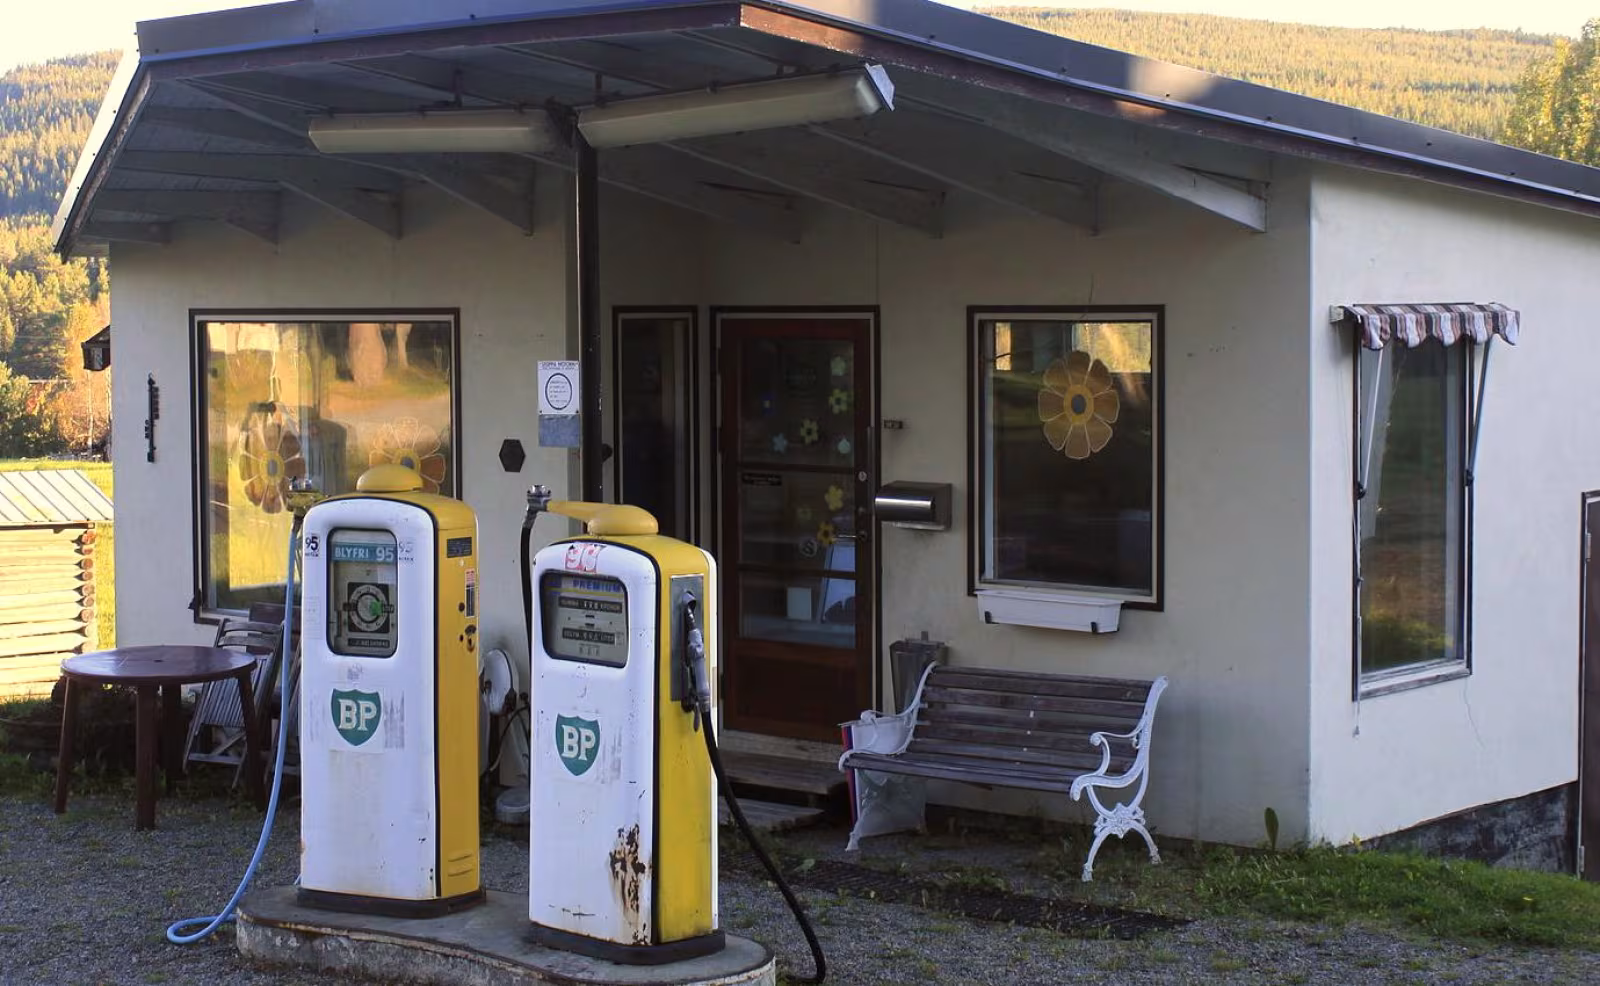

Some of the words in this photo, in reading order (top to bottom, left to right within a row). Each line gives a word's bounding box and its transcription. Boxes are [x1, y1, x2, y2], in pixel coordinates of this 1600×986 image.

[305, 536, 319, 551] 95
[334, 547, 369, 559] BLYFRI
[375, 547, 394, 562] 95
[572, 579, 622, 593] PREMIUM
[338, 698, 378, 731] BP
[561, 724, 596, 761] BP
